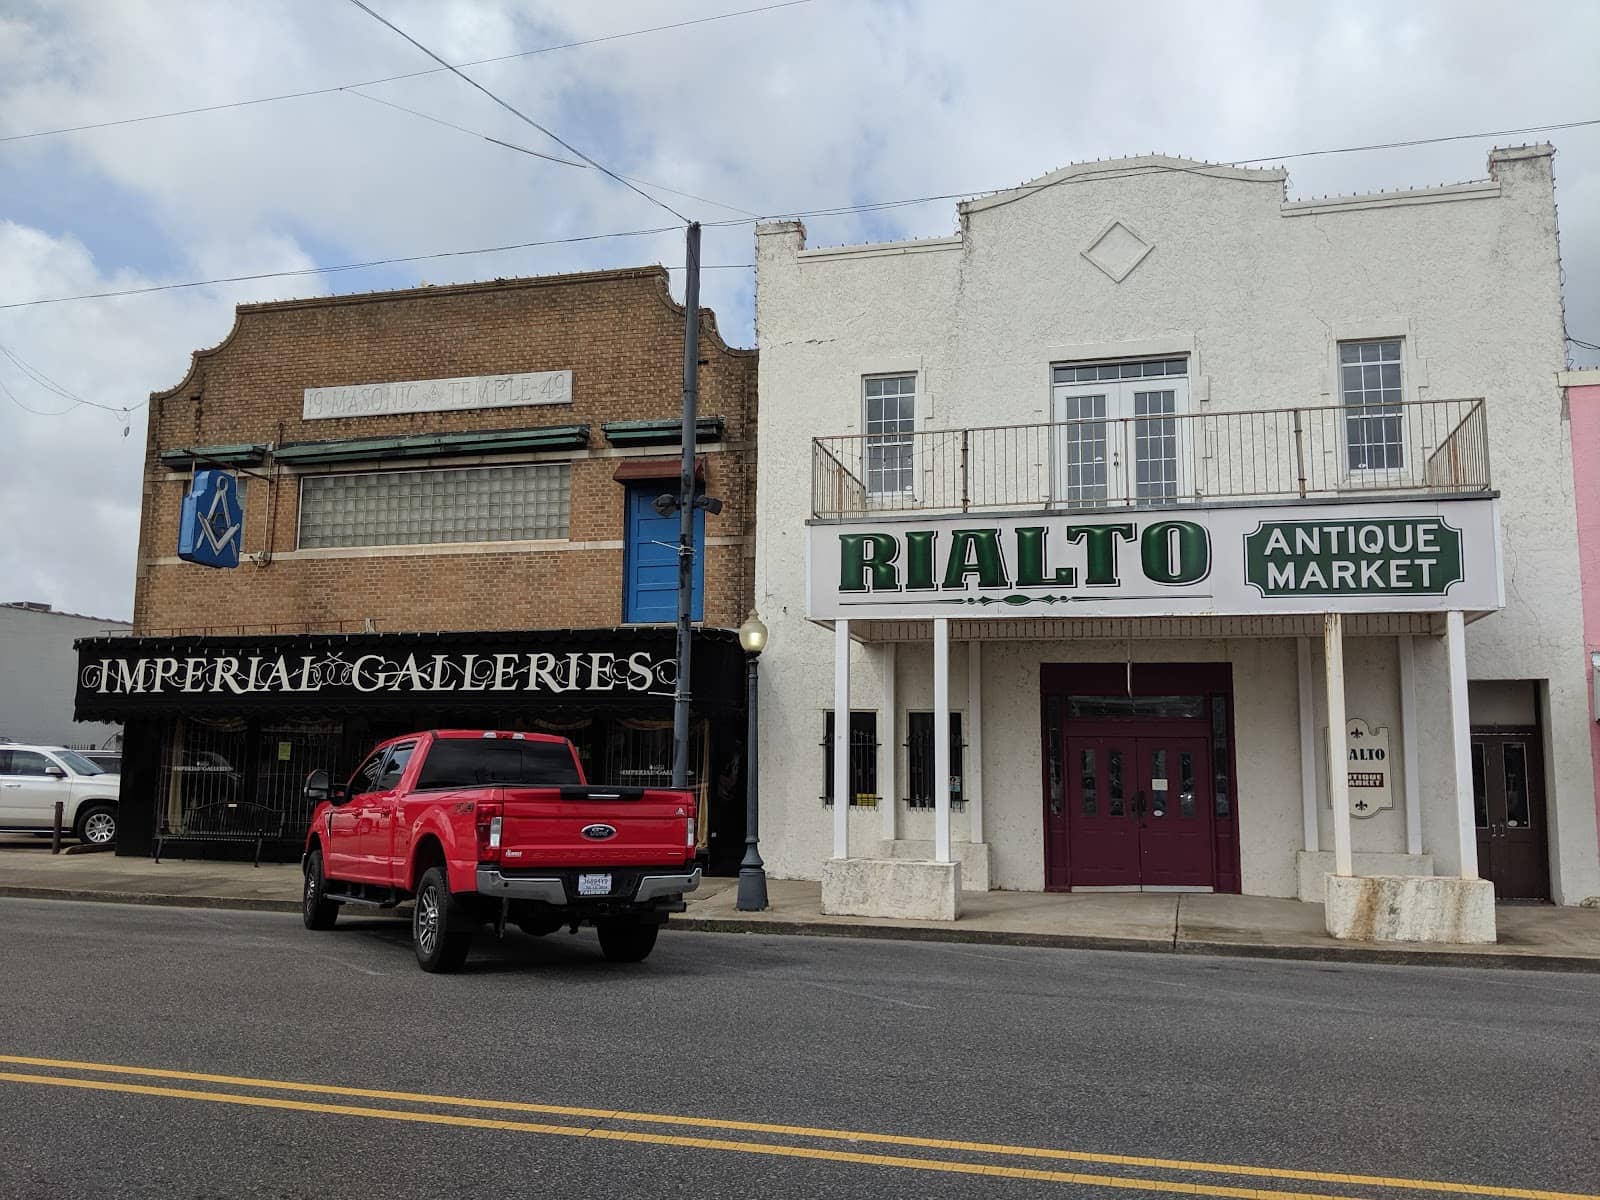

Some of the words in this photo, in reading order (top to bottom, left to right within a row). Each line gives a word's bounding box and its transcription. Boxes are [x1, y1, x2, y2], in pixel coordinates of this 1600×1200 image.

[1264, 524, 1441, 556] ANTIQUE
[838, 520, 1212, 593] RIALTO
[1267, 558, 1437, 590] MARKET
[96, 654, 322, 695] IMPERIAL
[352, 652, 653, 693] GALLERIES
[1349, 748, 1385, 760] ALTO
